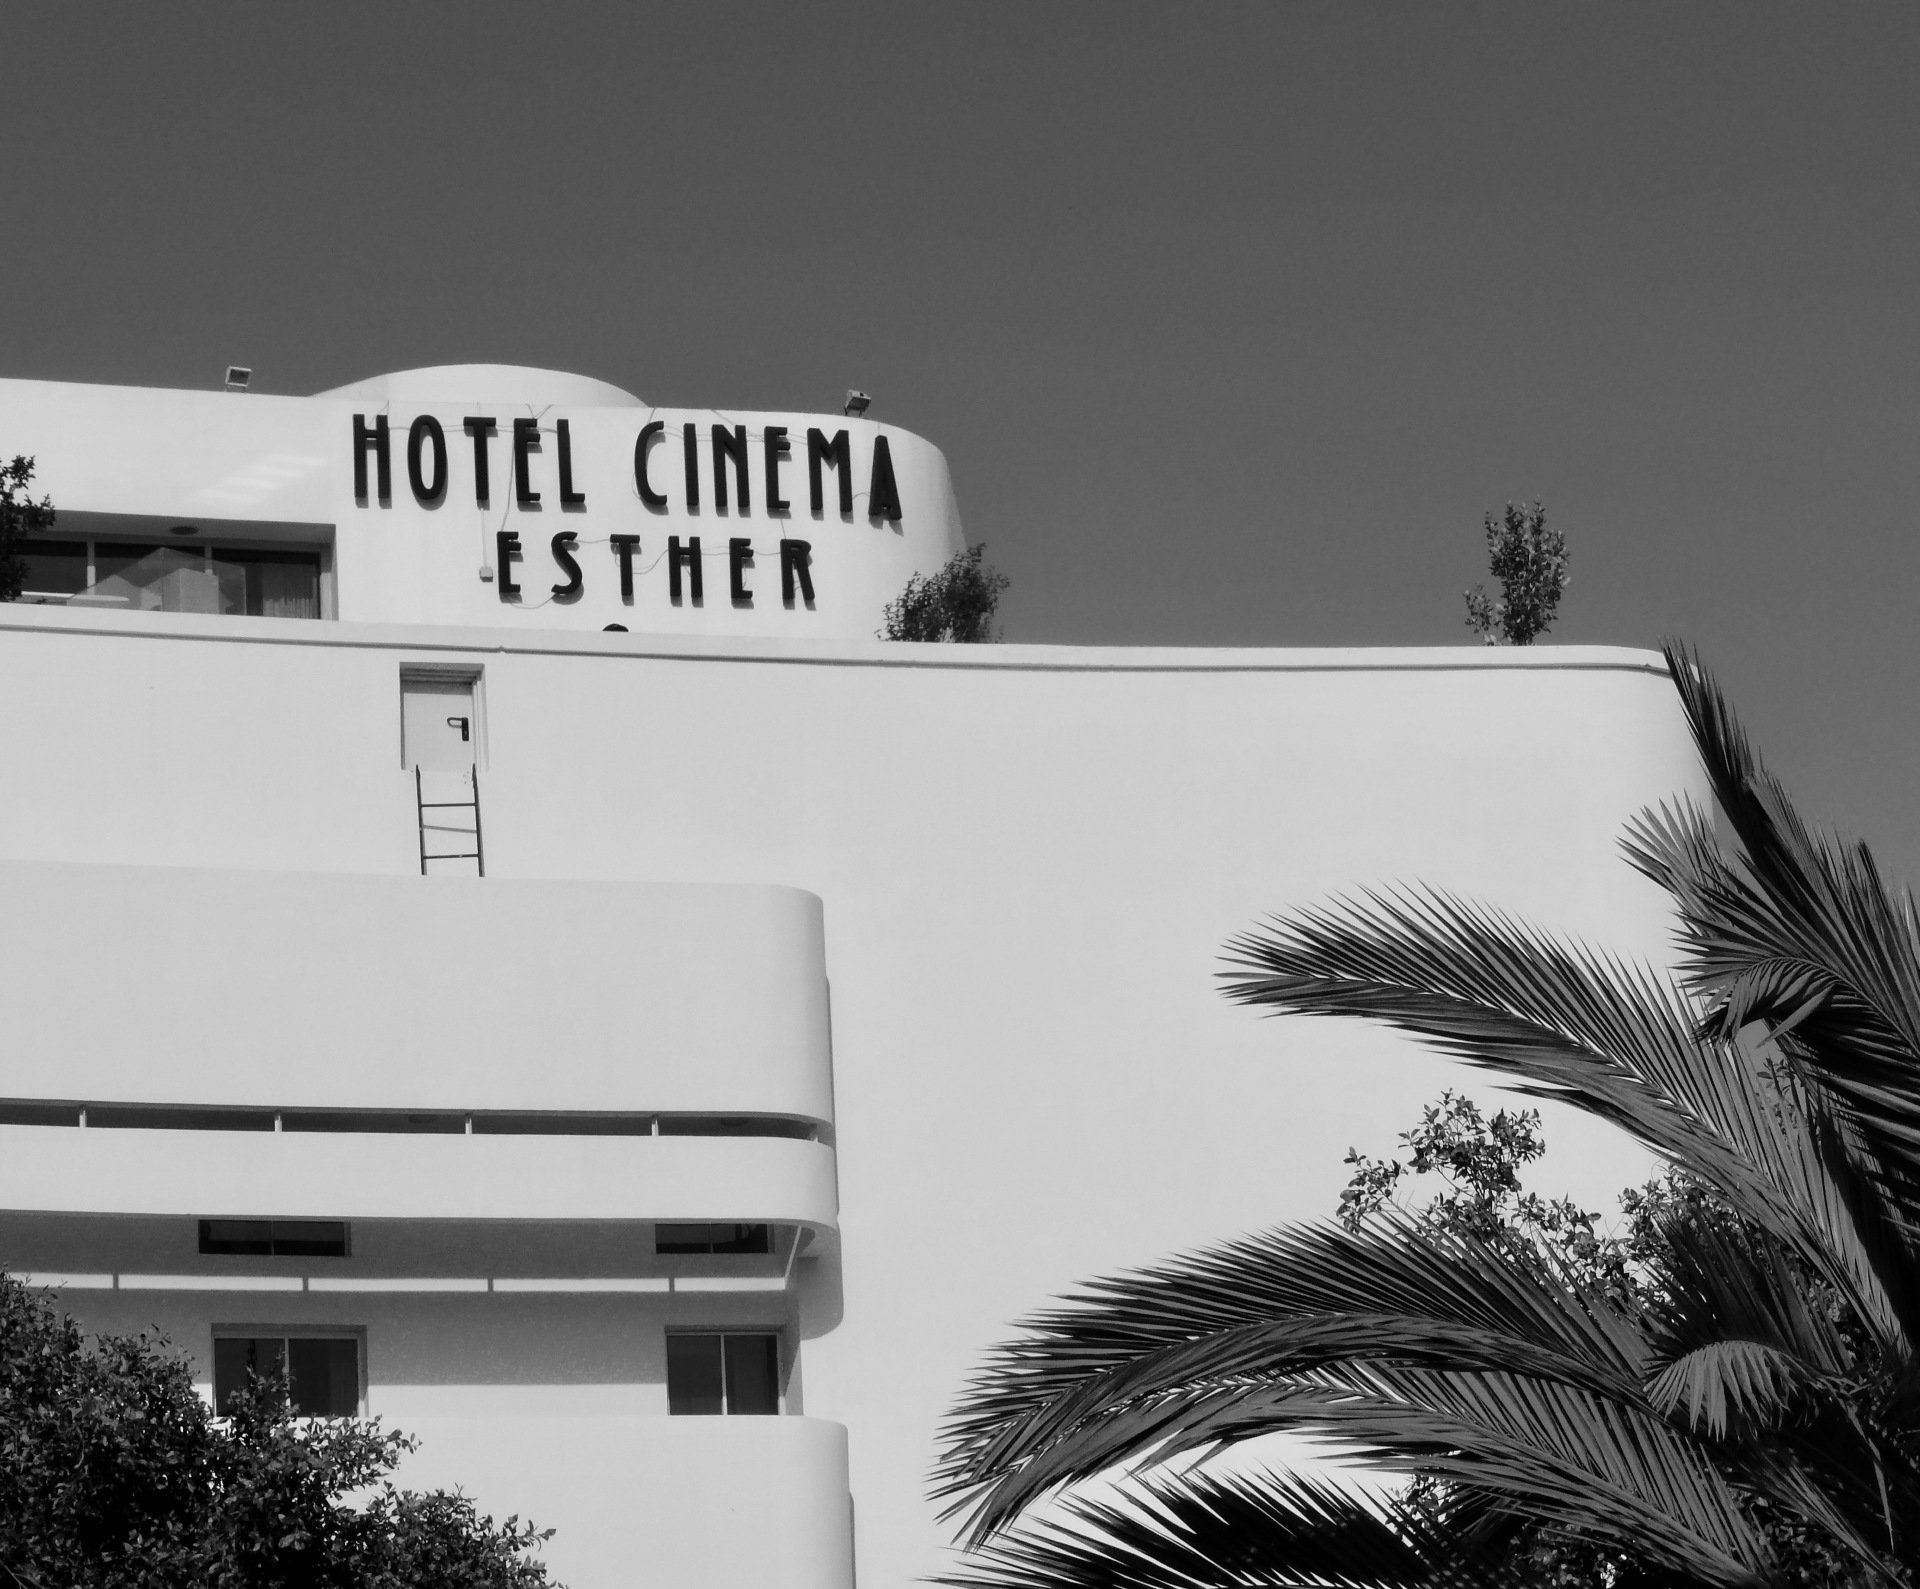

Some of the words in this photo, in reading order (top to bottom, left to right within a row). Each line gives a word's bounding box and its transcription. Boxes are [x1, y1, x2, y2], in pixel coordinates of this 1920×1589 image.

[352, 414, 586, 506] HOTEL
[634, 421, 903, 521] CINEMA
[497, 531, 815, 601] ESTHER
